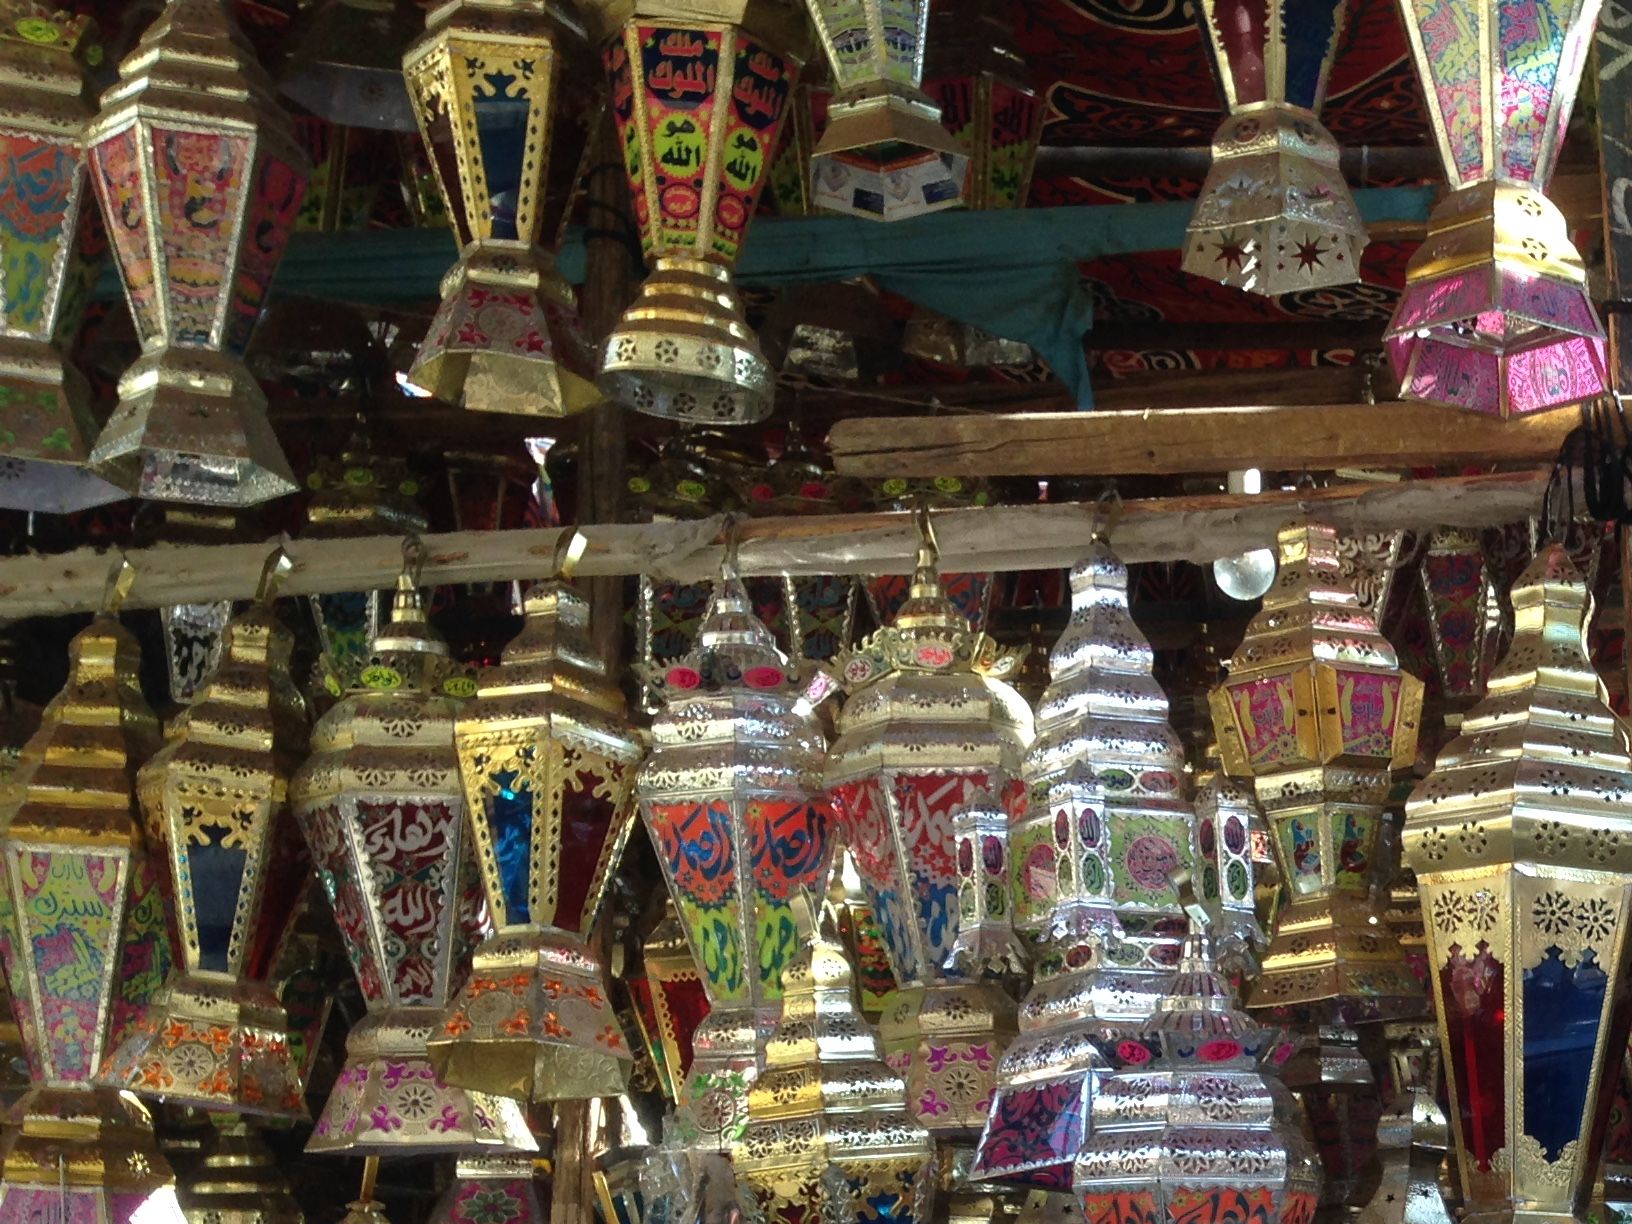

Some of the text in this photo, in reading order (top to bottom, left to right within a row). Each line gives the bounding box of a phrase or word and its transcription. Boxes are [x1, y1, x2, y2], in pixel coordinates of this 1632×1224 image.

[659, 31, 704, 58] ملك
[649, 60, 714, 98] الملوك
[747, 51, 782, 81] ملك
[734, 74, 782, 120] الملوك
[660, 119, 696, 138] هو
[731, 132, 758, 152] هو
[660, 138, 701, 166] الله
[725, 154, 757, 183] الله
[383, 887, 436, 934] الله
